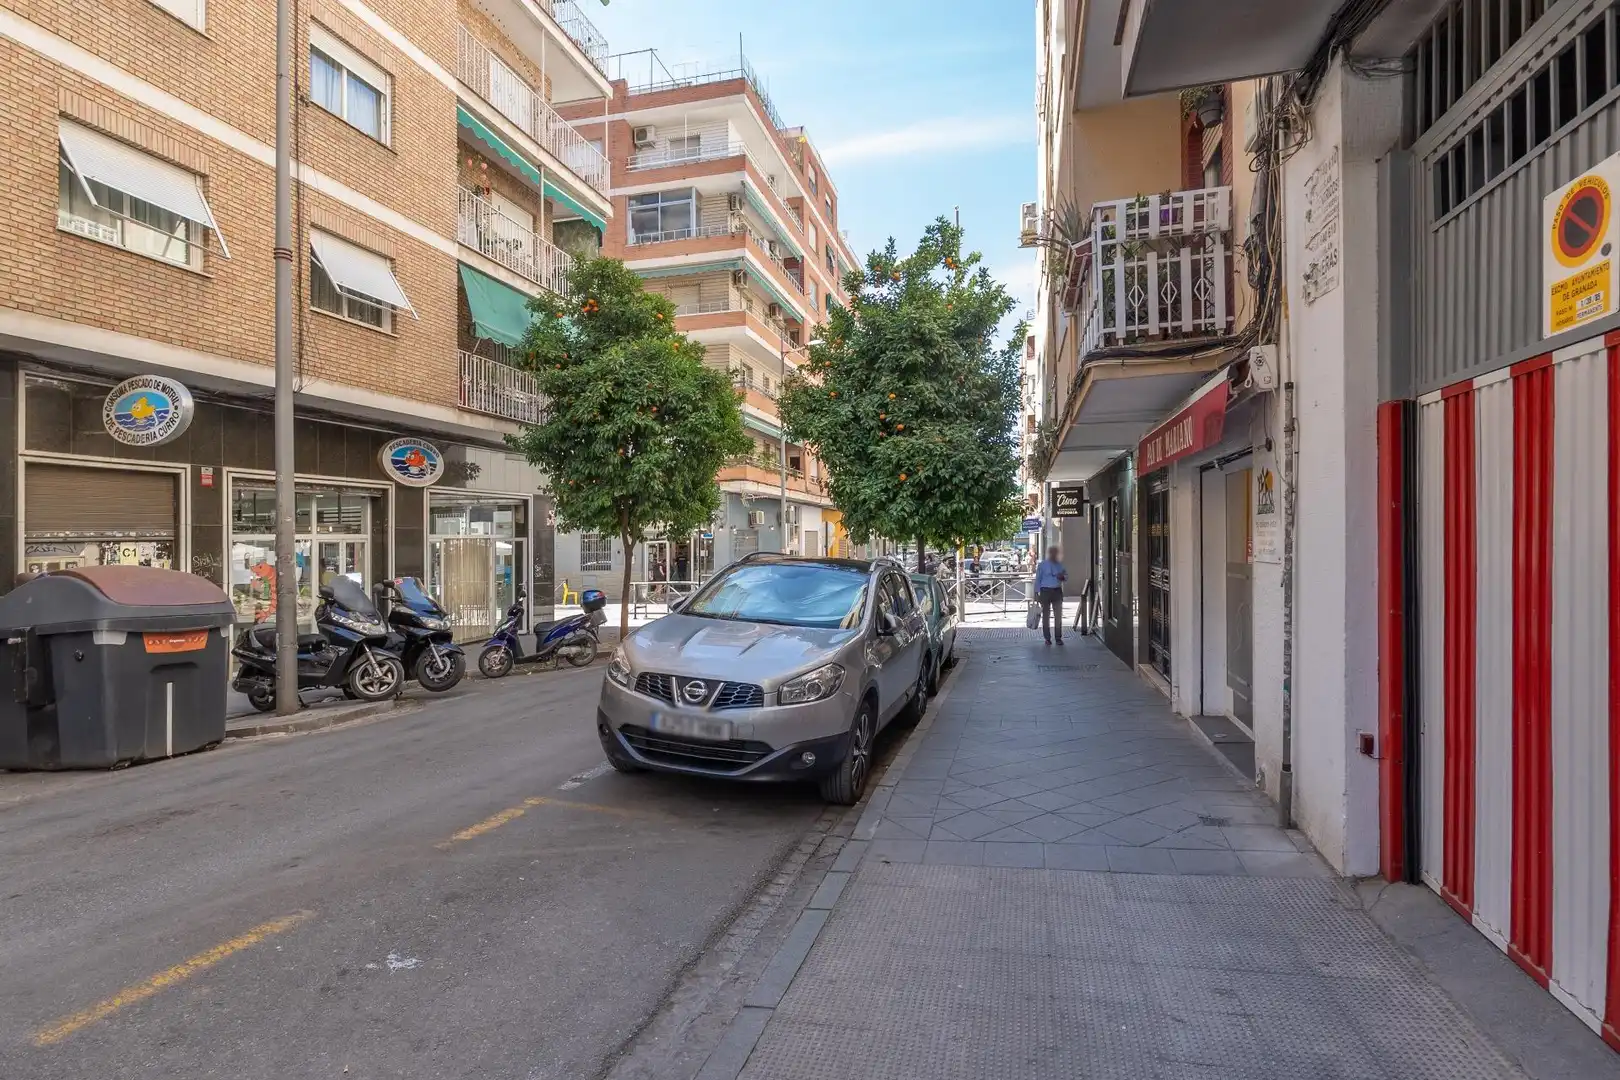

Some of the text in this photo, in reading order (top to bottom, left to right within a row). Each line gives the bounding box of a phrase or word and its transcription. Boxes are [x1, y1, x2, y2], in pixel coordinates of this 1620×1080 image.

[1552, 204, 1564, 229] PASO
[1566, 187, 1575, 199] DE
[1572, 261, 1610, 286] AYUNTAMIENTO
[1562, 280, 1598, 301] DE GRANADA
[104, 379, 180, 412] CONSUMA PESCADO DE MOTRIL
[105, 411, 180, 444] DE PESCADERIA CURRO
[1165, 415, 1193, 458] MARIANO
[388, 439, 440, 459] PESCADERIA CURRO
[122, 547, 138, 558] C1
